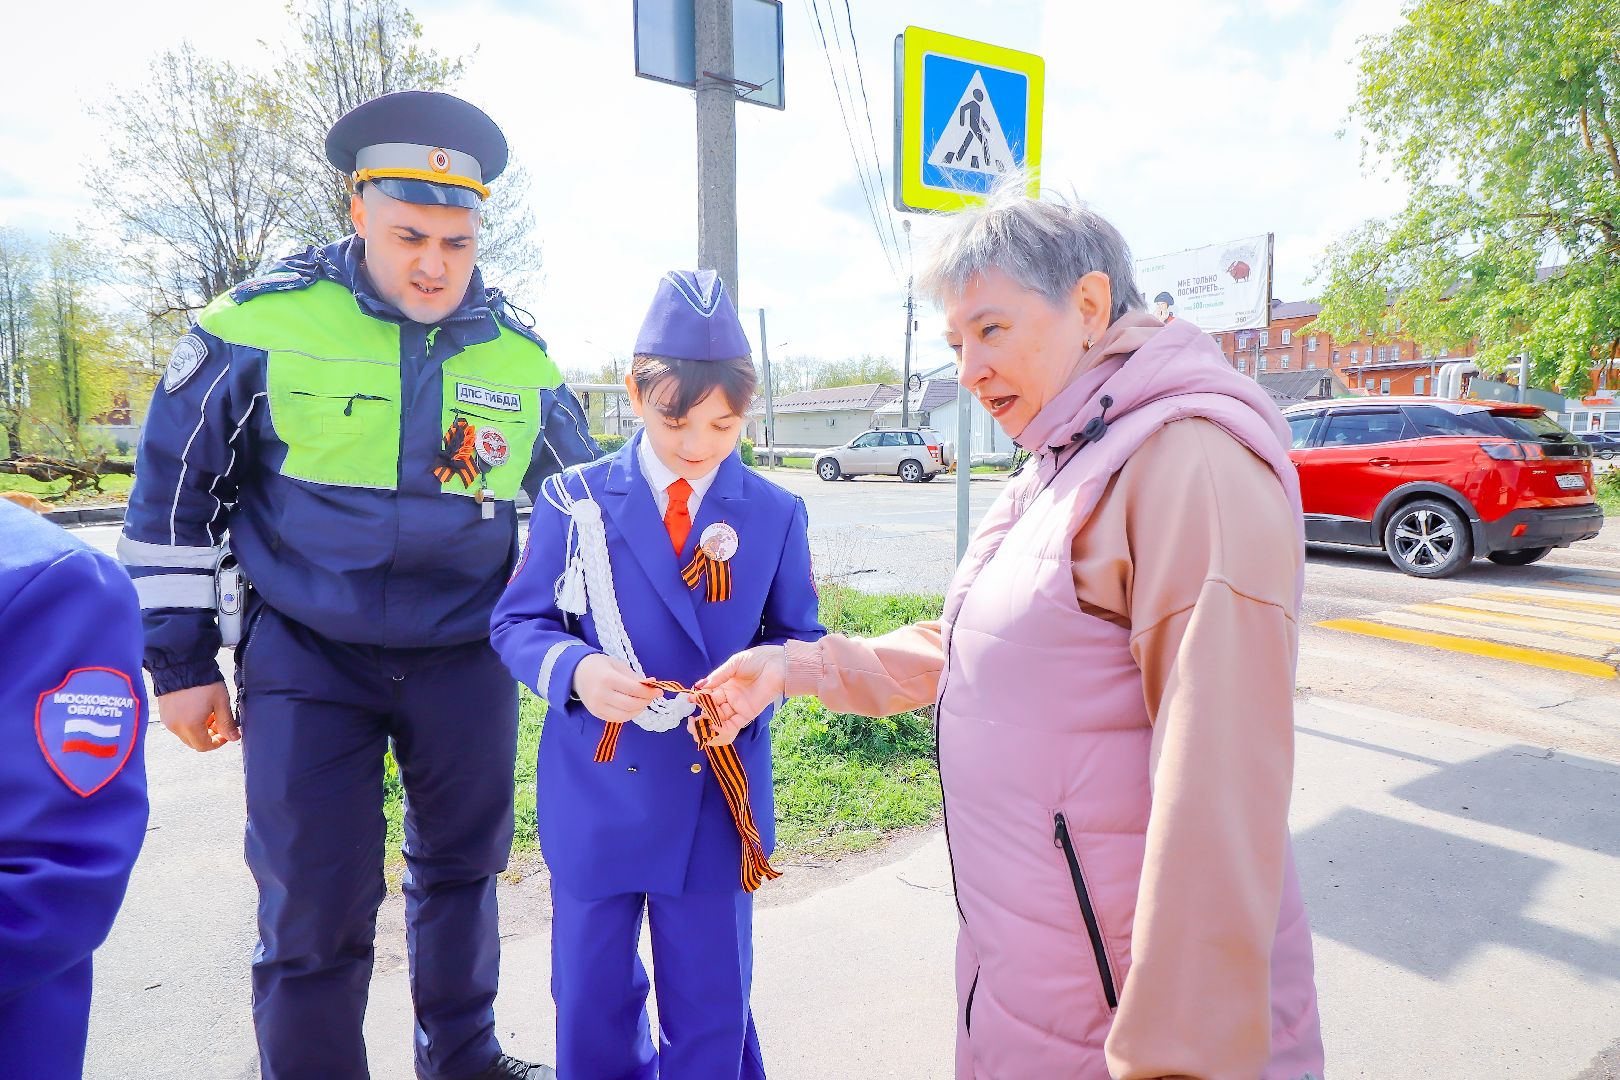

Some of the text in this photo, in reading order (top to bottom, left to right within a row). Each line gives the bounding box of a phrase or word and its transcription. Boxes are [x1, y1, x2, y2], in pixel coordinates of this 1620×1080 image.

[460, 387, 482, 399] ДПС
[53, 693, 134, 709] МОСКОВСКАЯ
[67, 705, 123, 718] ОБЛАСТЬ
